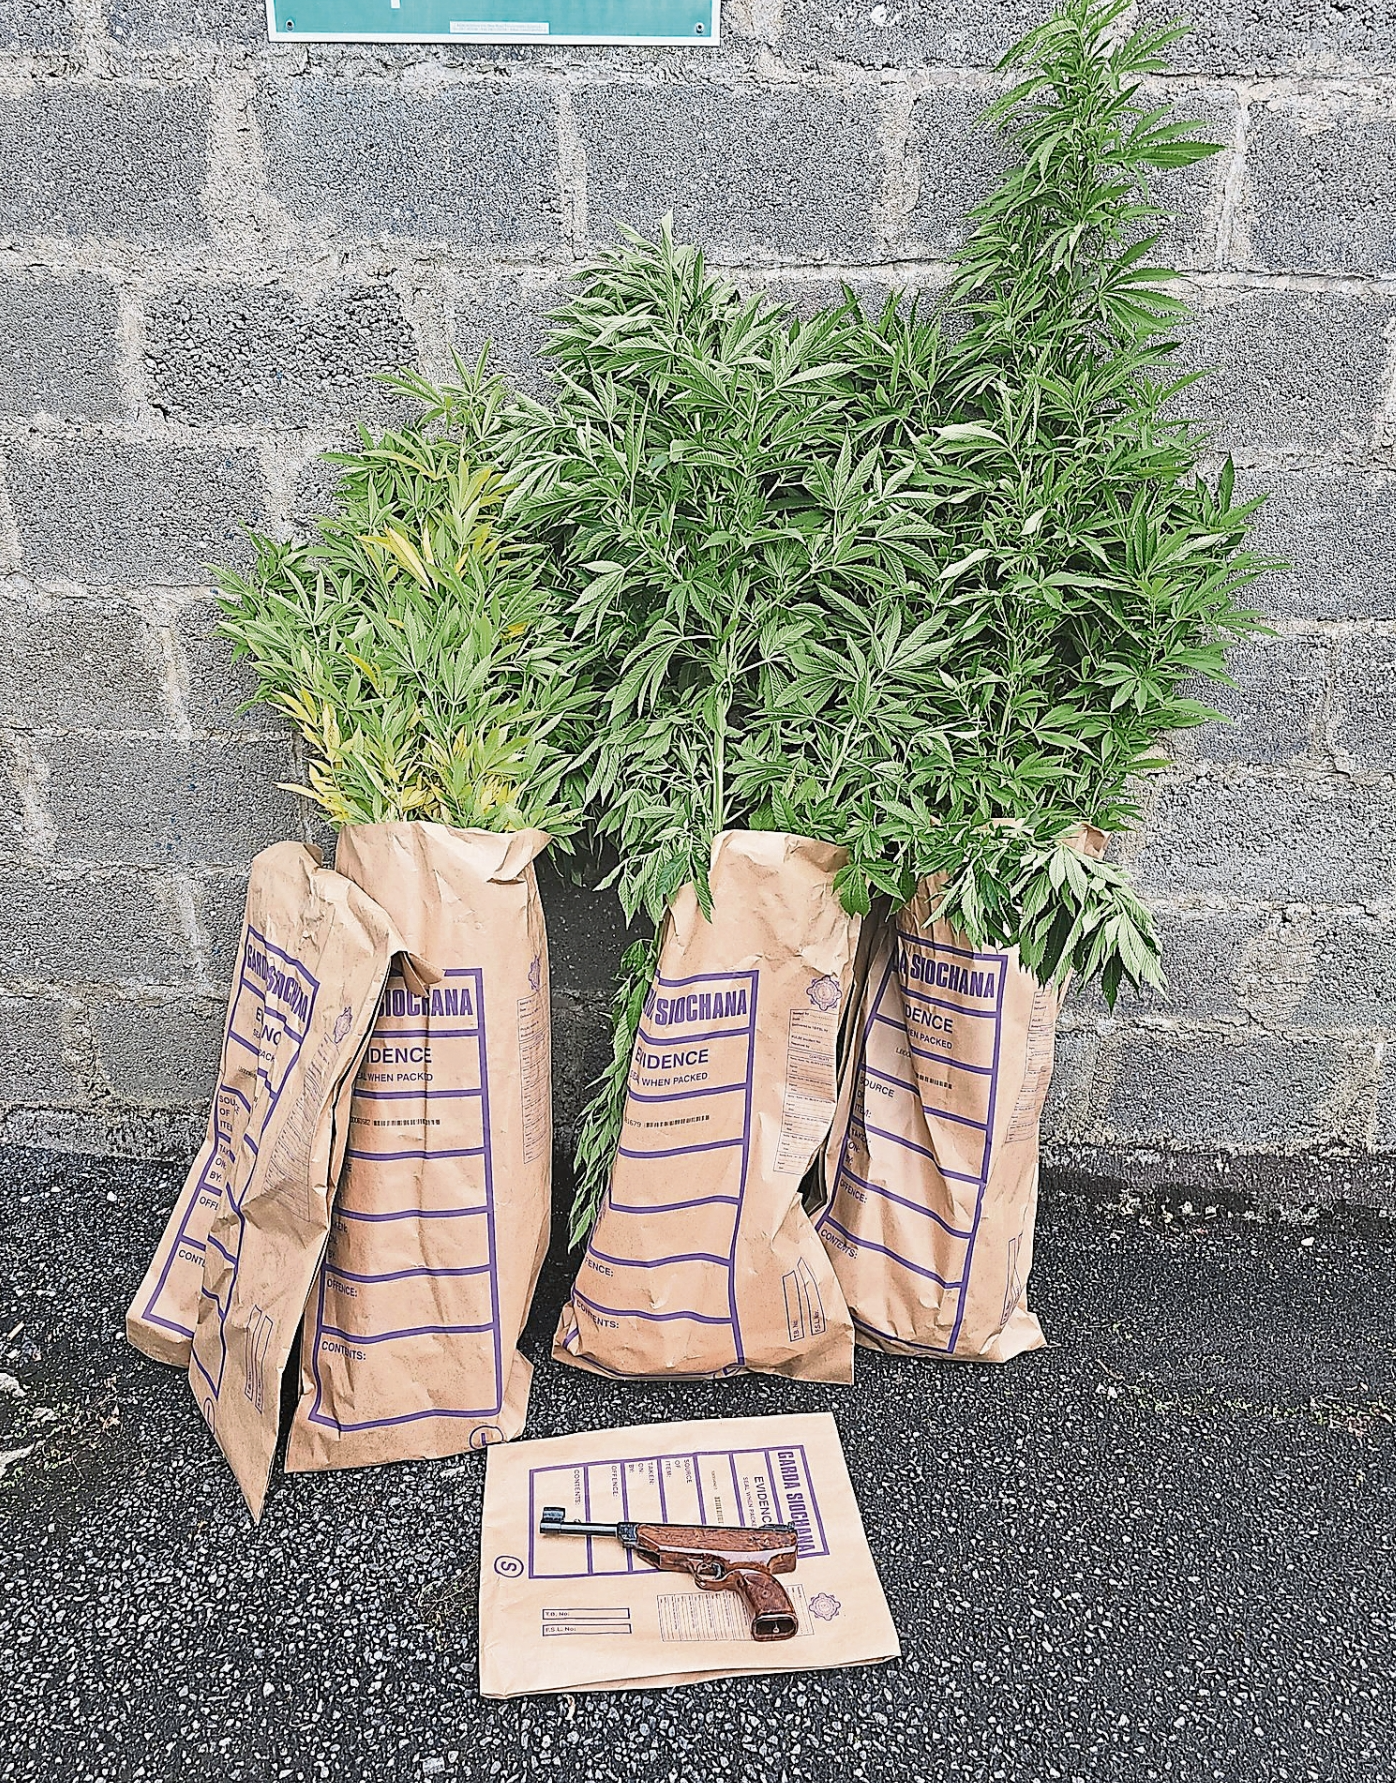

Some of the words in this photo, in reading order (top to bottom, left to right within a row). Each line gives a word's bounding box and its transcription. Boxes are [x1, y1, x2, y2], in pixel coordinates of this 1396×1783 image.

[910, 953, 996, 999] SIOCHANA
[654, 989, 748, 1026] SIOCHANA
[919, 1032, 954, 1050] PACKED
[366, 1047, 432, 1064] IDENCE
[367, 1073, 394, 1082] WHEN
[641, 1077, 671, 1087] WHEN
[672, 1072, 708, 1085] PACKED
[859, 1076, 895, 1099] SOURCE
[326, 1278, 358, 1298] OFFENCE:
[321, 1341, 366, 1361] CONTENTS:
[683, 1459, 693, 1484] SOURCE
[777, 1451, 801, 1490] GARDA
[753, 1476, 773, 1524] EVIDENC
